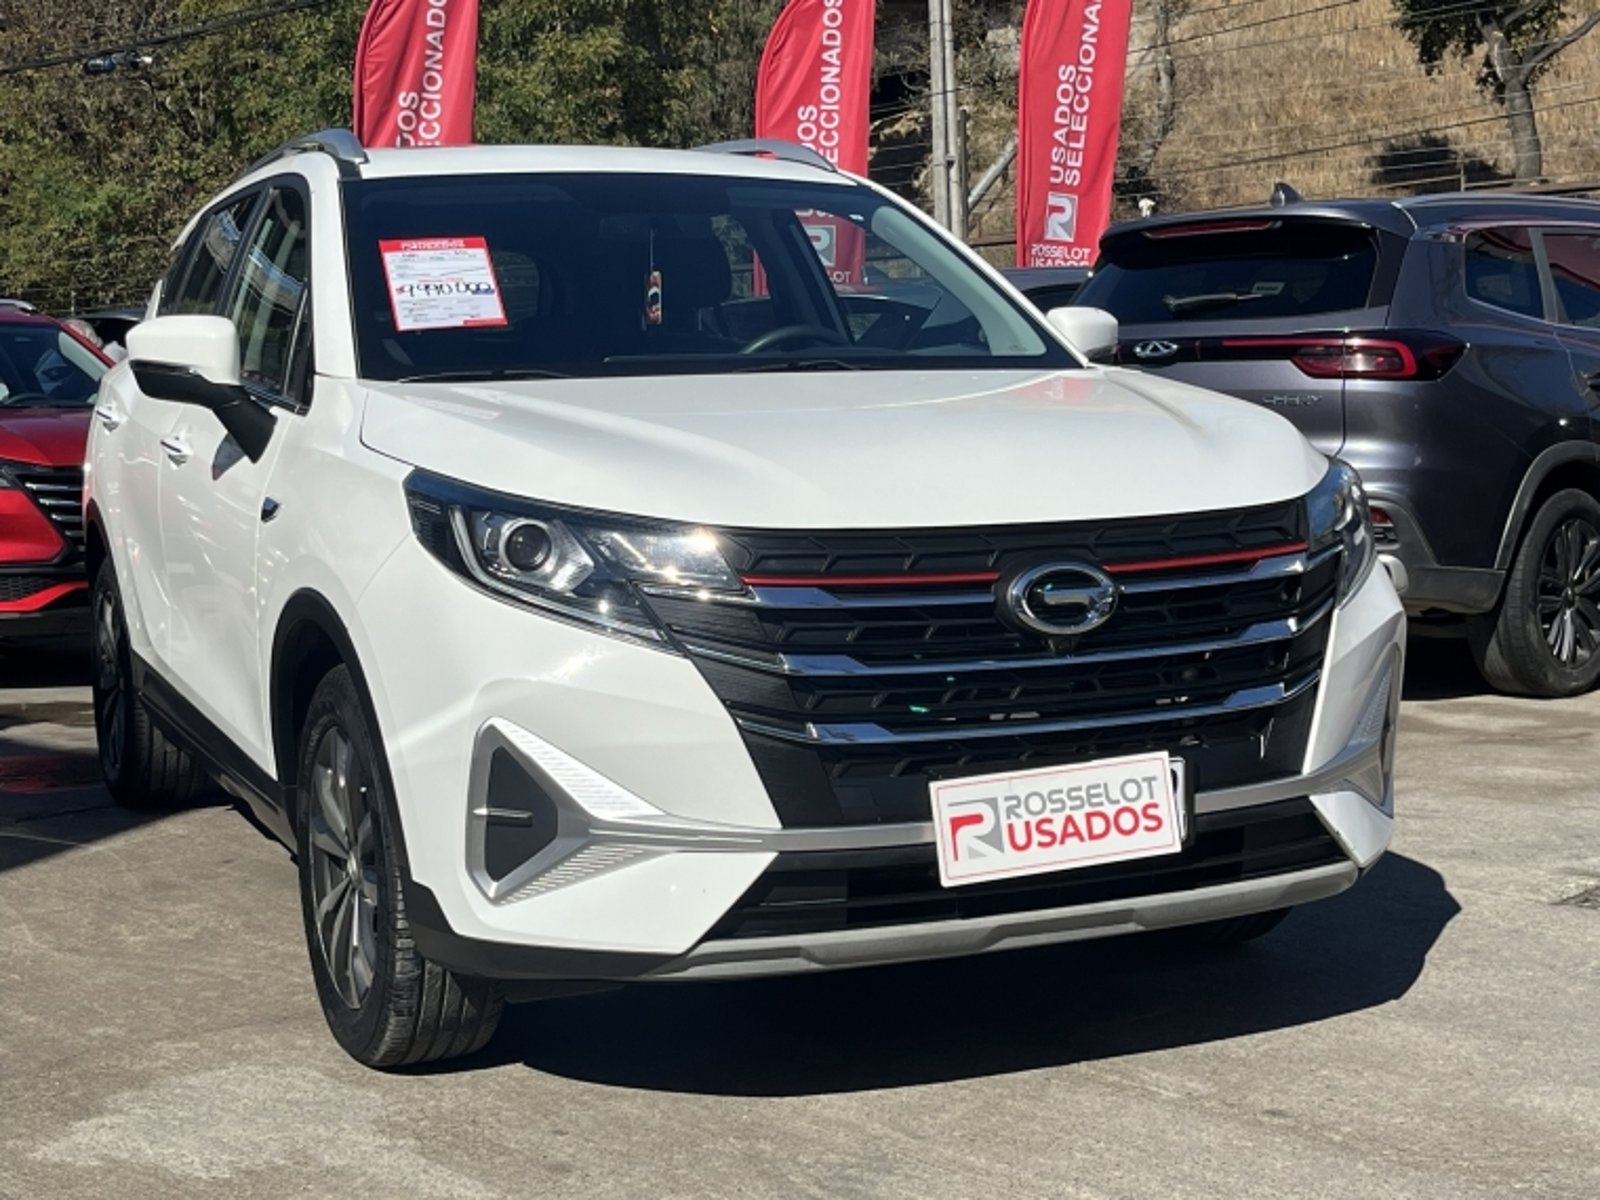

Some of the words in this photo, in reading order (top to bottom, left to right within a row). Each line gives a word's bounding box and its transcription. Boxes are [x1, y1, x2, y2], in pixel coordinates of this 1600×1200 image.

[1065, 0, 1102, 186] SELECCIONA
[1050, 64, 1077, 184] USADOS
[1031, 244, 1091, 260] ROSSELOT
[1004, 776, 1158, 820] ROSSELOT
[1007, 803, 1164, 852] USADOS
